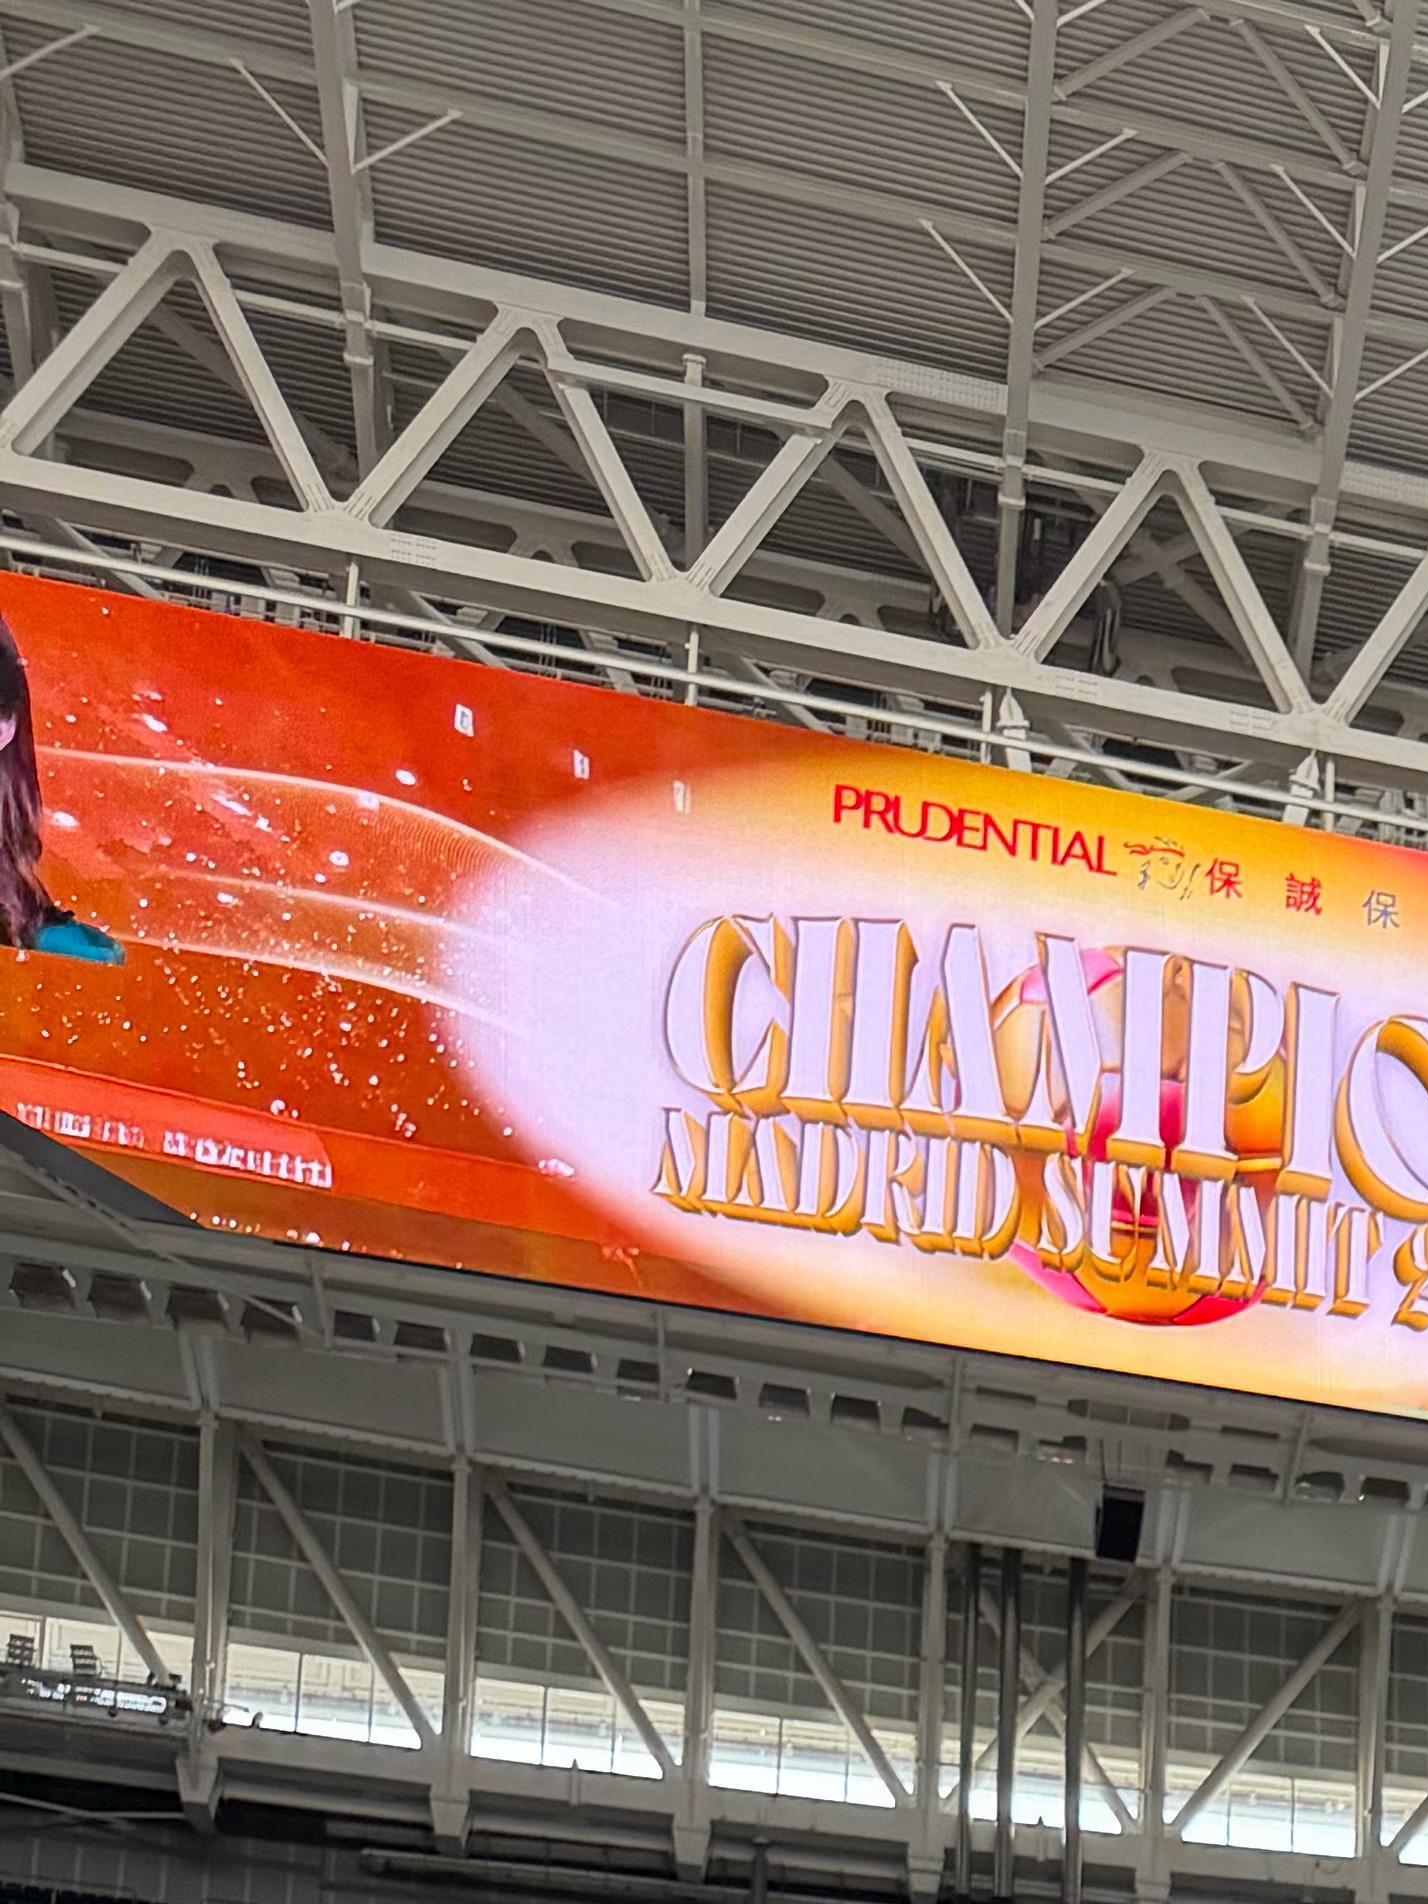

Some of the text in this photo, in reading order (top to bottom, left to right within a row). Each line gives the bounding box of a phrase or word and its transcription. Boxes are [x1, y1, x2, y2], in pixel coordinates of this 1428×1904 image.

[833, 784, 1118, 877] PRUDENTIAL
[652, 1106, 1020, 1260] MADRID
[1038, 1152, 1385, 1320] SUMMIT
